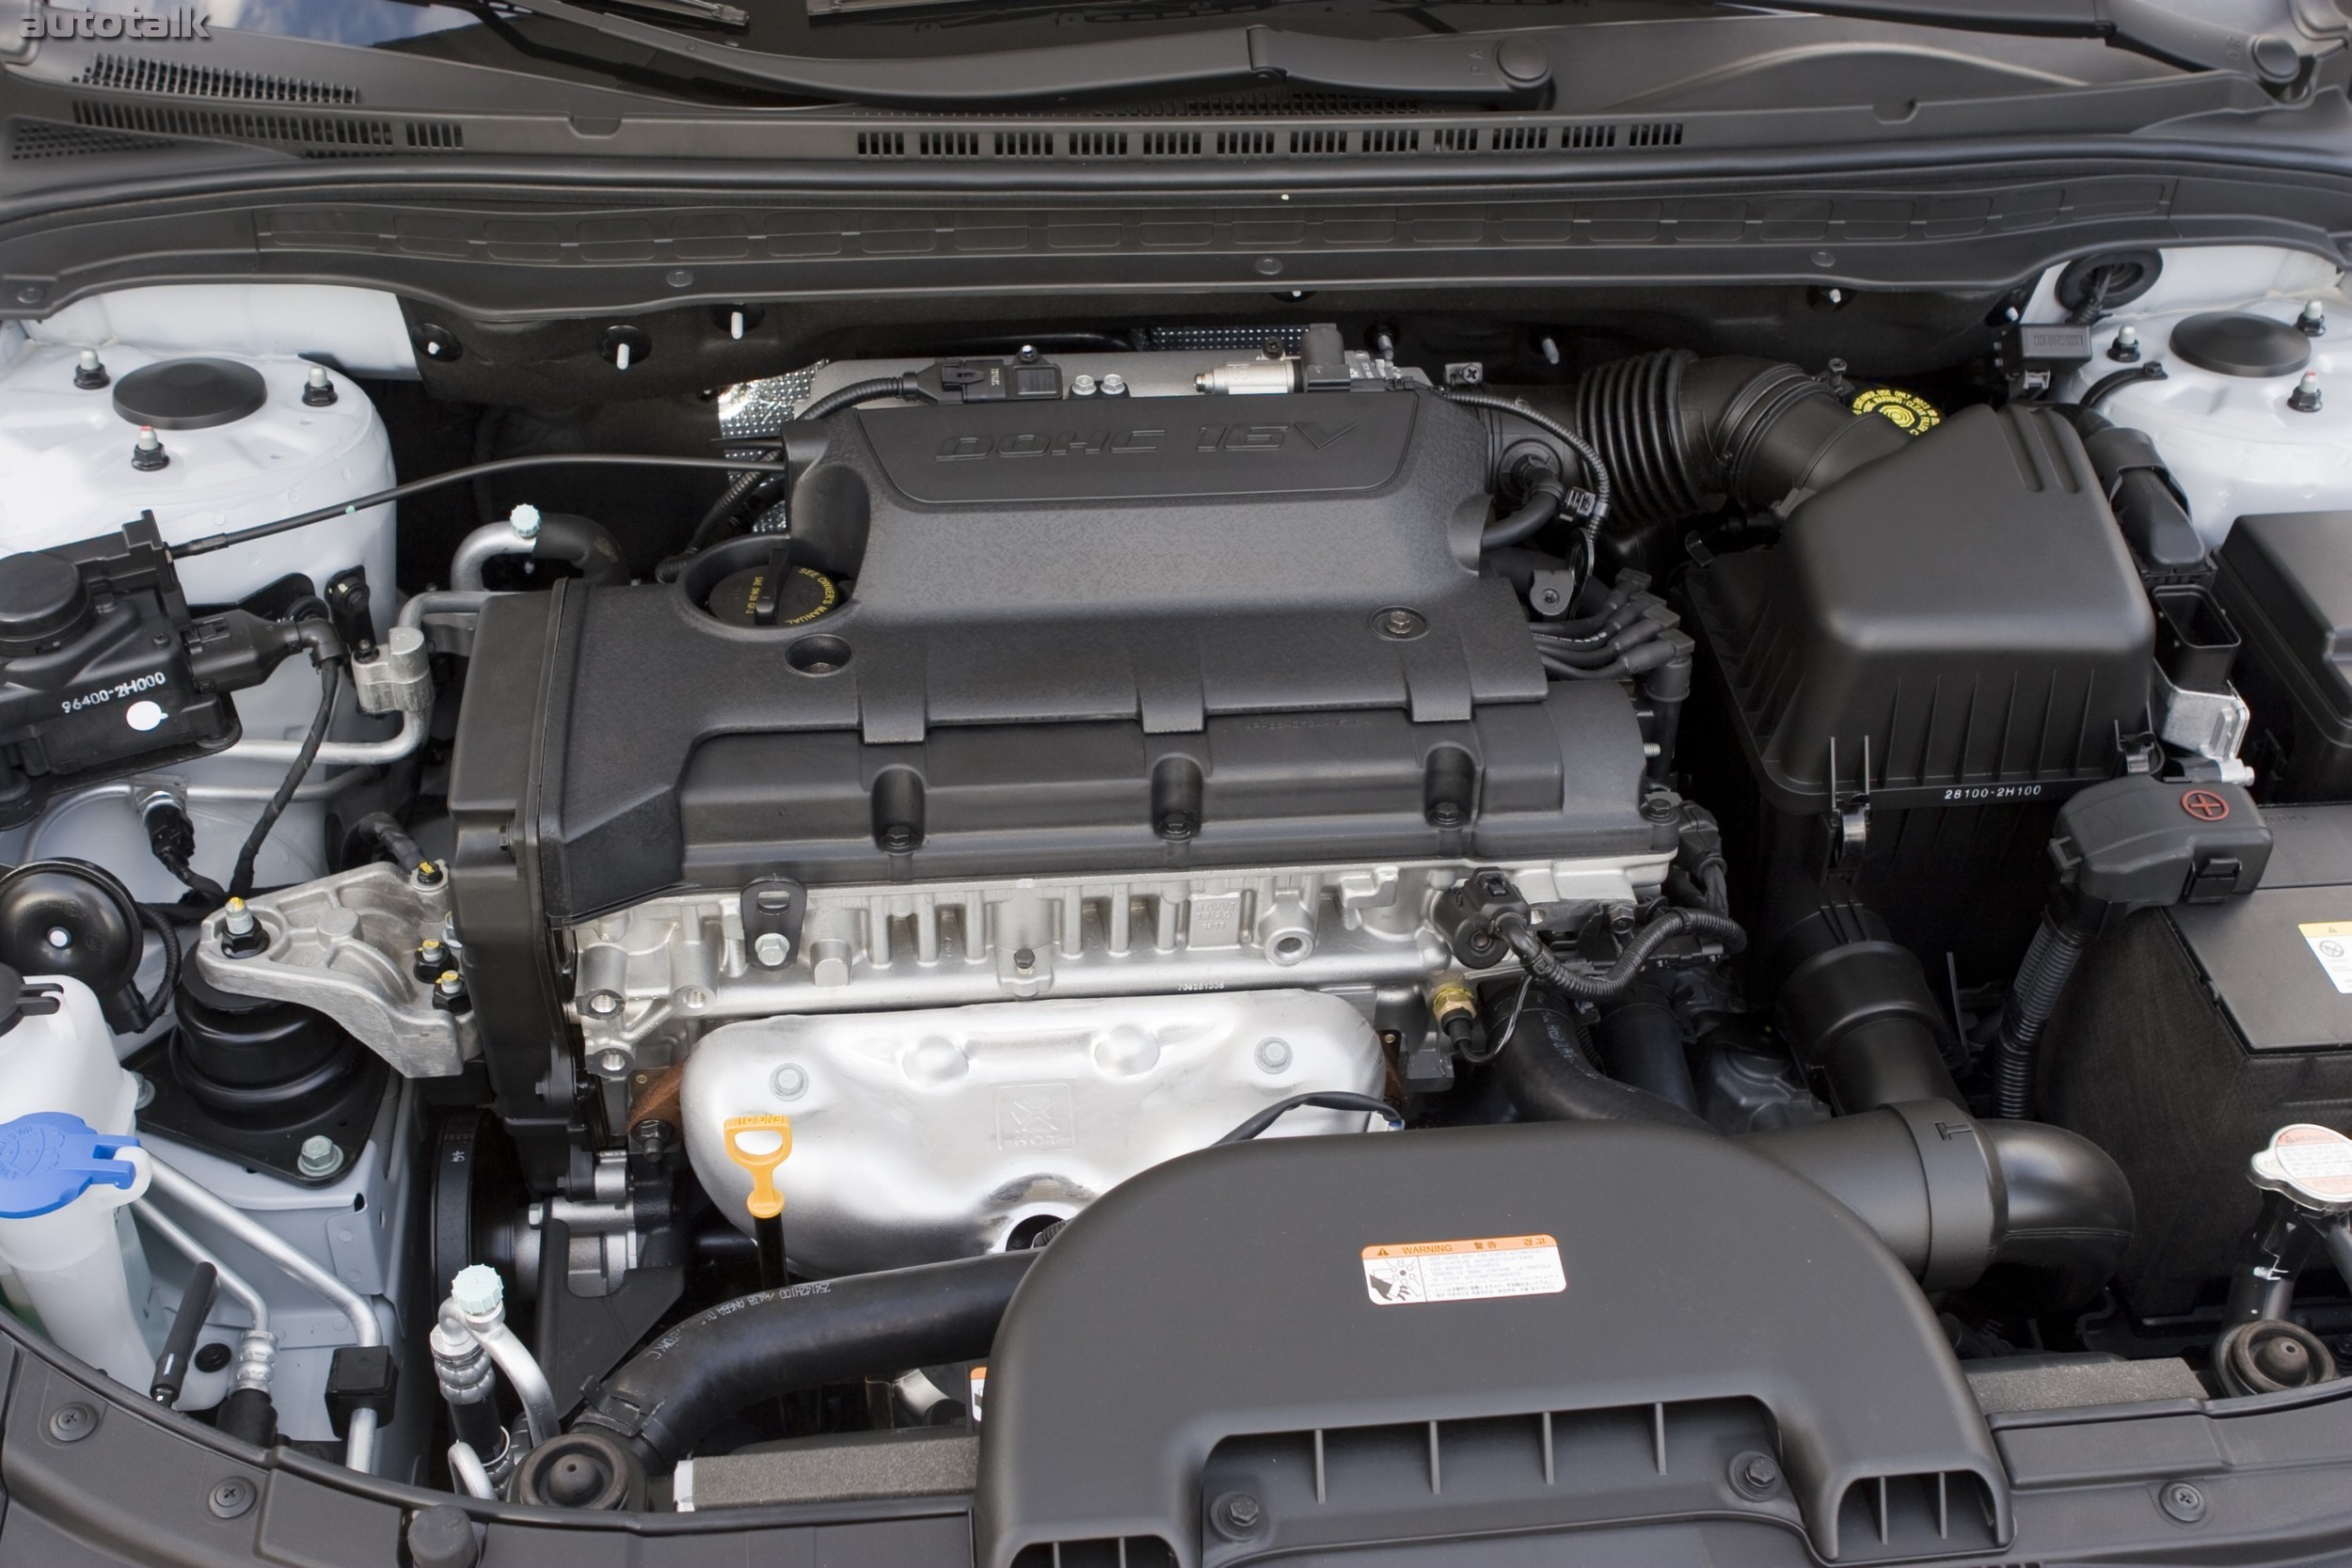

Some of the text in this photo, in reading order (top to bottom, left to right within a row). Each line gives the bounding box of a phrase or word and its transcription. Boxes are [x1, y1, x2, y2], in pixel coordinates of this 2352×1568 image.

[935, 421, 1359, 461] DOHC 16V
[785, 567, 835, 625] SEE OWNER'S MANUAL
[61, 672, 167, 713] 96400-2H000
[1944, 784, 2042, 800] 28100-2H100
[1402, 1243, 1454, 1255] WARNING
